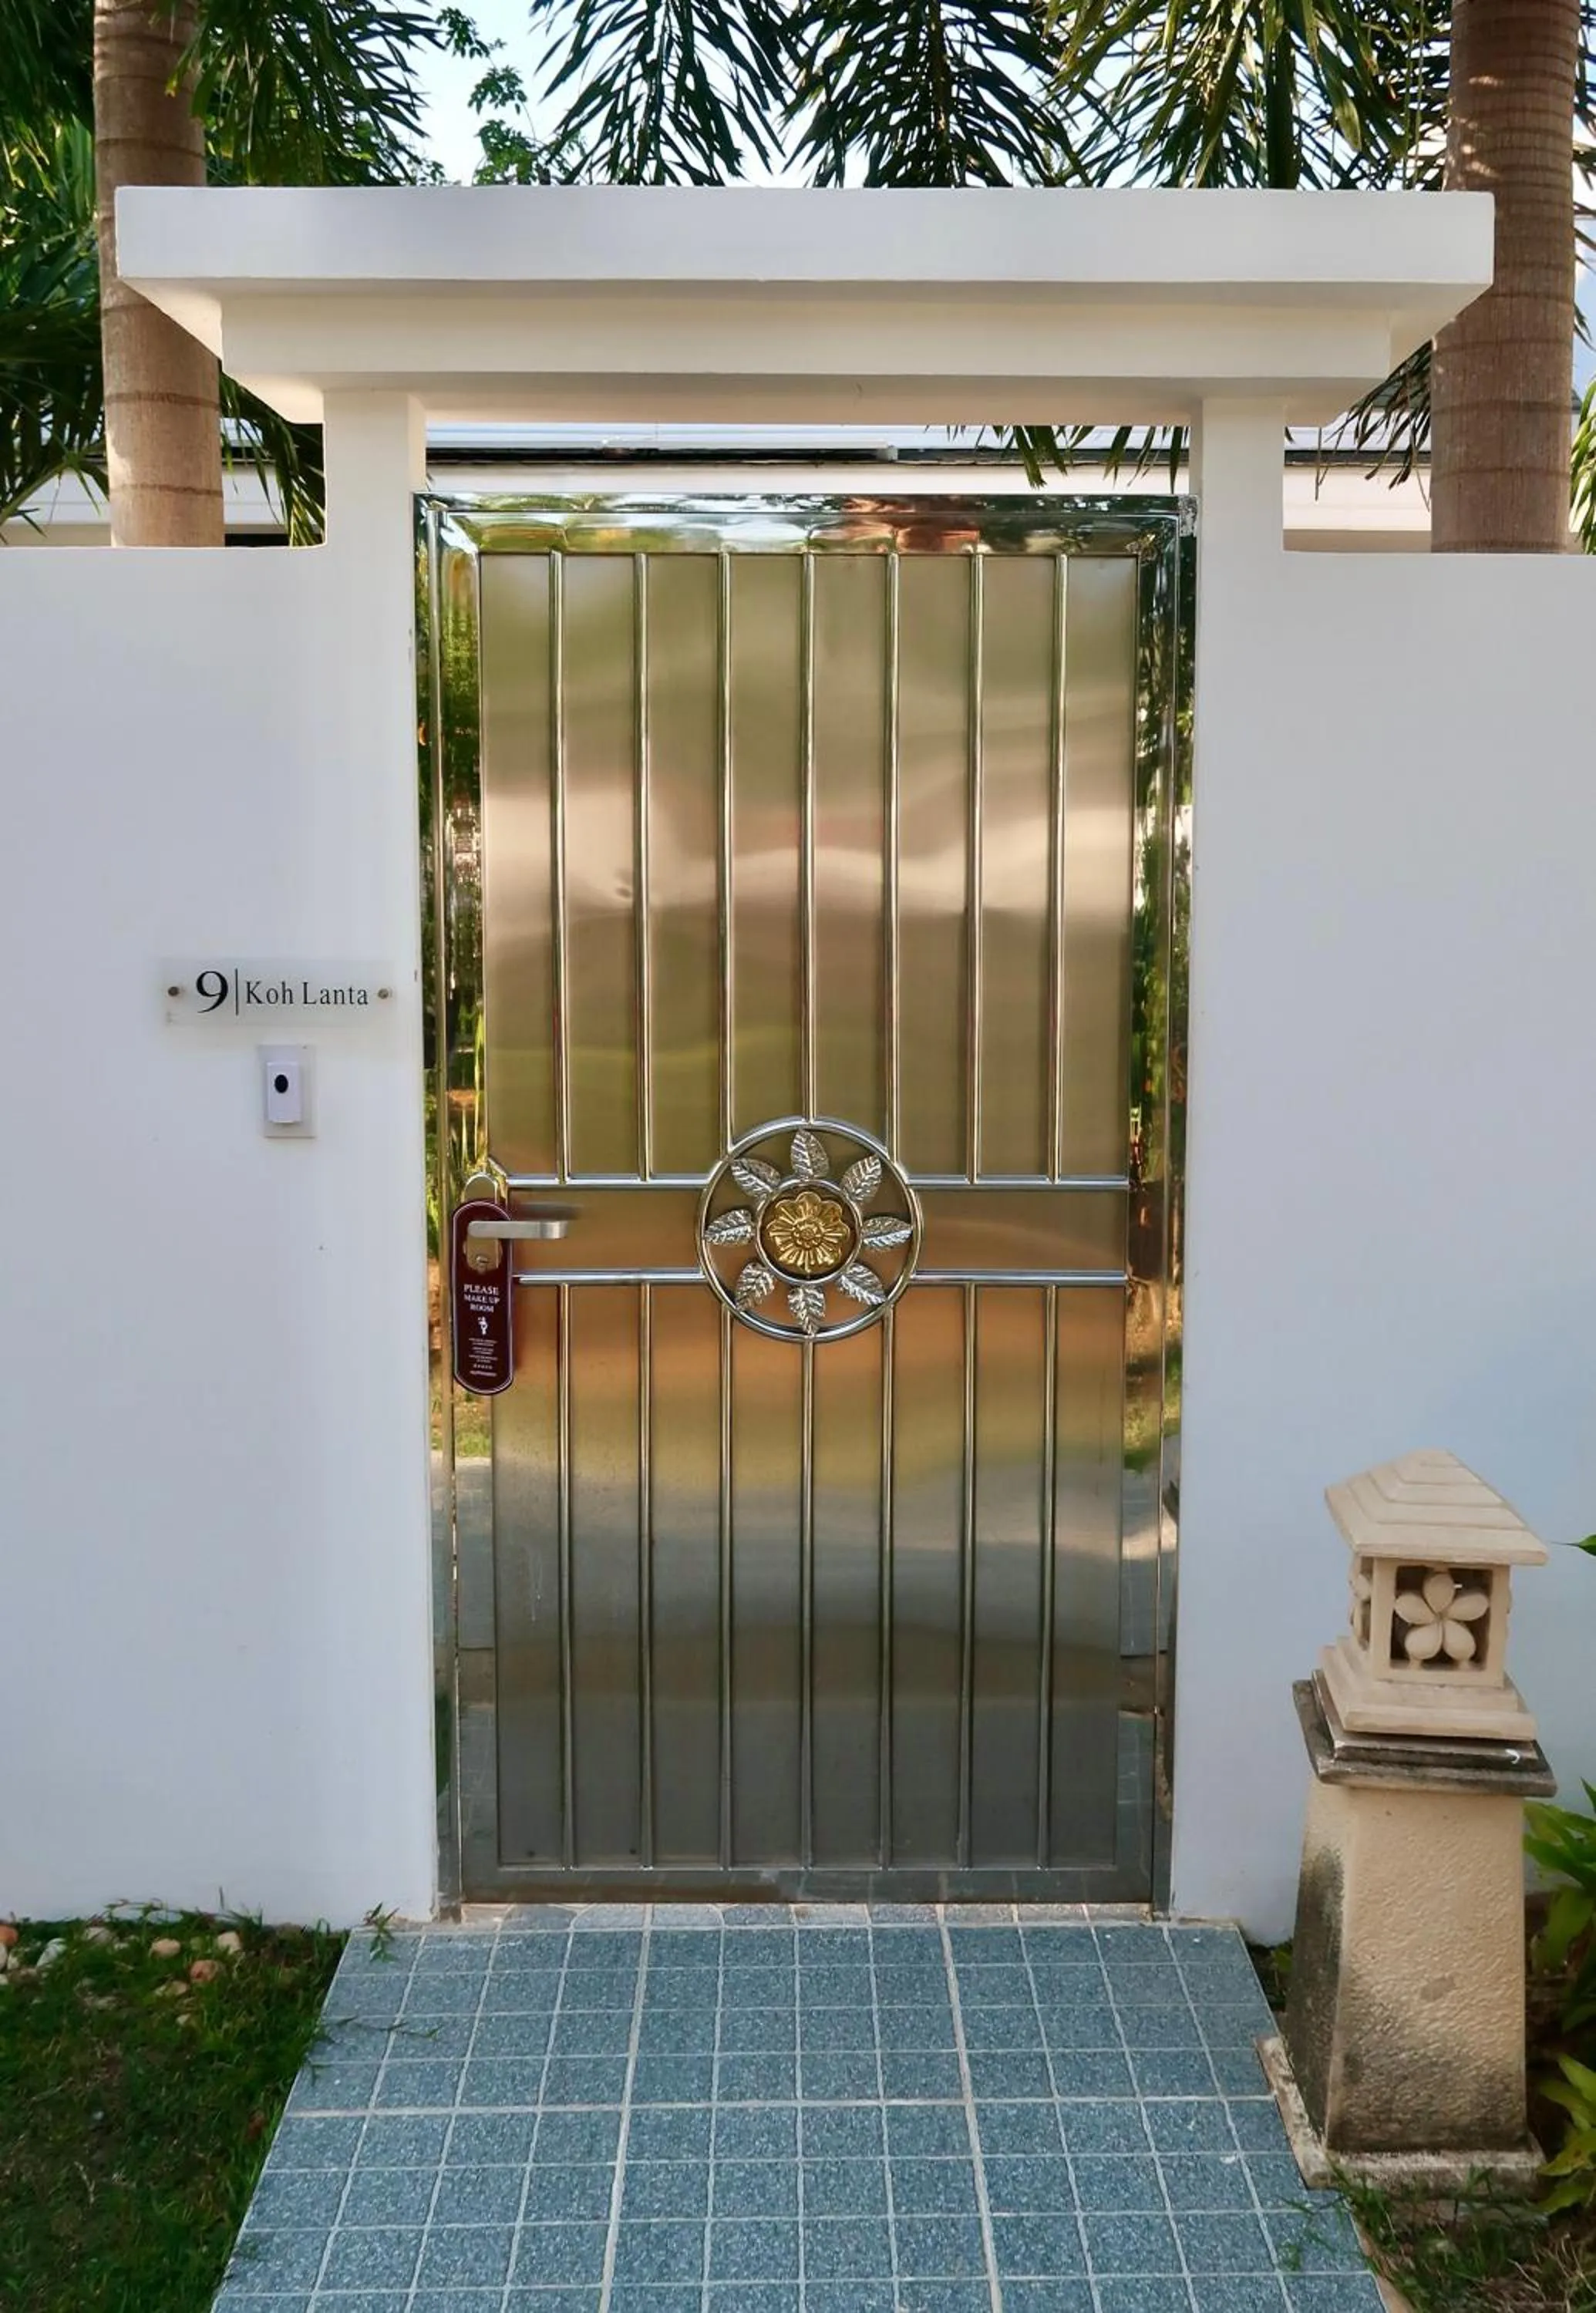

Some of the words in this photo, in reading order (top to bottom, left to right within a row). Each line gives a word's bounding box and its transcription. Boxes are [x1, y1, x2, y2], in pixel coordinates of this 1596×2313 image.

[195, 971, 229, 1014] 9
[246, 981, 295, 1005] Koh
[302, 981, 369, 1005] Lanta
[463, 1284, 500, 1295] PLEASE
[463, 1295, 487, 1303] MAKE
[470, 1303, 494, 1312] ROOM
